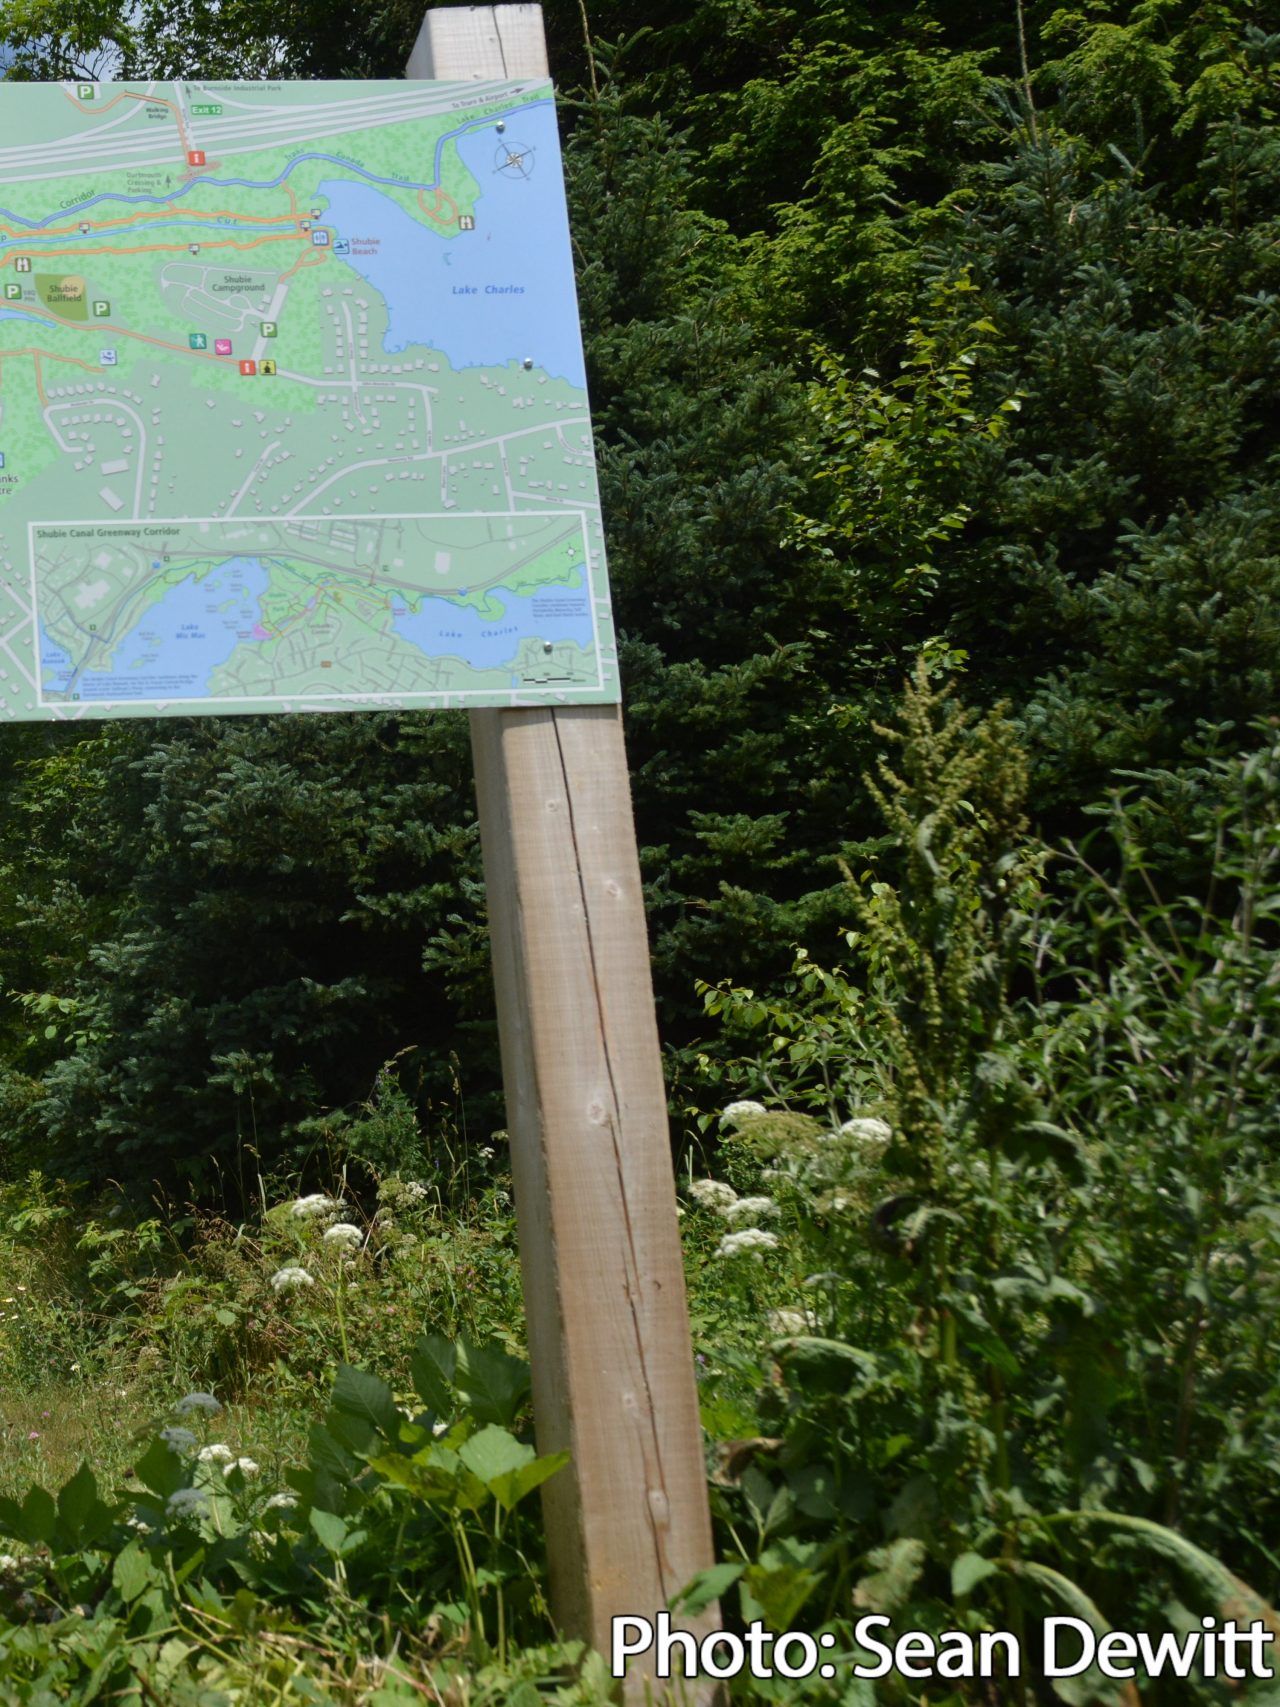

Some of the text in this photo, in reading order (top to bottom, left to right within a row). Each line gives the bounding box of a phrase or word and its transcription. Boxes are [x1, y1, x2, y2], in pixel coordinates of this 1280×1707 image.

[193, 106, 209, 114] Exit
[456, 114, 474, 124] Lake
[484, 102, 513, 115] Charles
[336, 151, 365, 168] Canada
[60, 190, 95, 209] Corridor
[217, 217, 238, 225] Cut
[352, 238, 381, 246] Shubie
[224, 275, 251, 284] Shubie
[49, 285, 78, 293] Shubie
[212, 283, 265, 293] Campground
[453, 285, 525, 294] Lake Charles
[48, 294, 82, 303] Ballfield
[38, 530, 67, 538] Shubie
[97, 529, 141, 537] Greenway
[144, 528, 180, 536] Corridor
